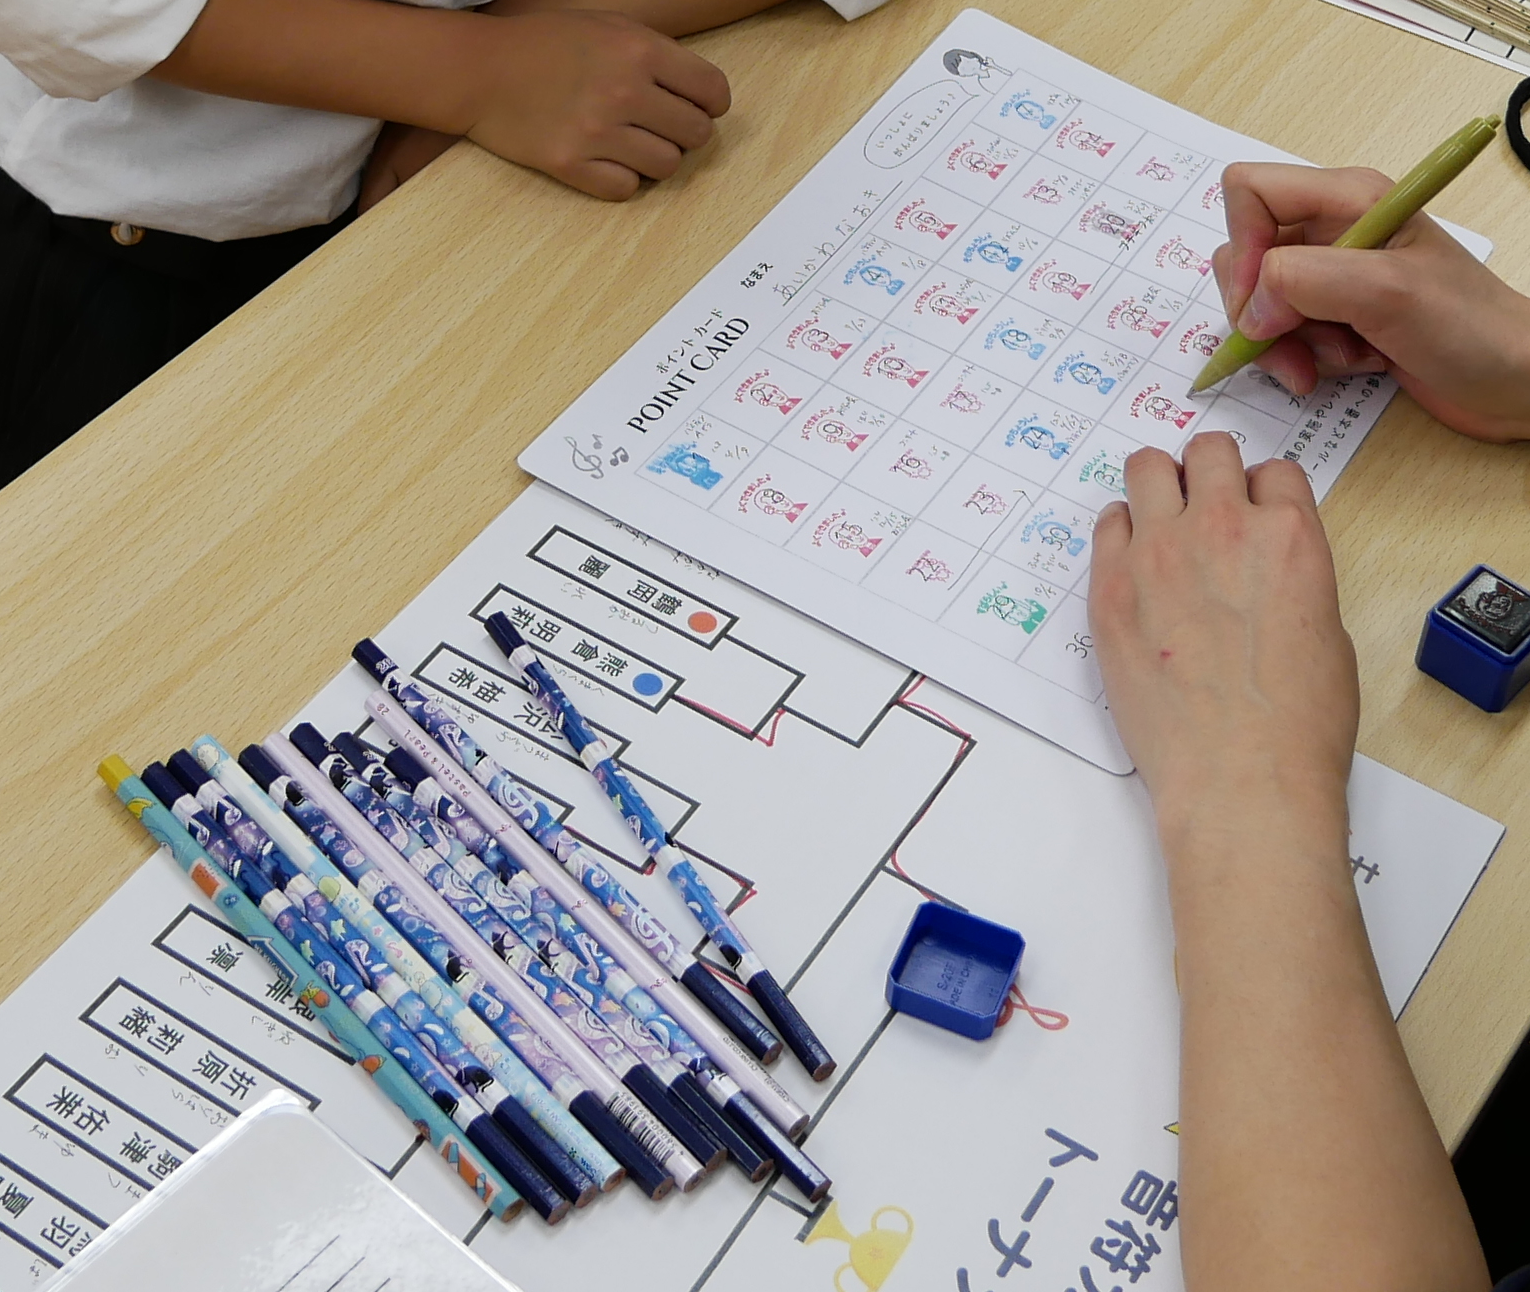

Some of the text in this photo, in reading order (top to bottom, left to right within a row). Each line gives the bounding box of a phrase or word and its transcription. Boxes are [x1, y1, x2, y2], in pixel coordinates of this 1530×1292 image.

[875, 111, 913, 149] いっしょに
[1145, 162, 1171, 181] 21
[1032, 185, 1058, 204] 13
[914, 211, 937, 226] 5
[1098, 213, 1126, 235] 20
[740, 262, 774, 289] なまえ
[1051, 272, 1077, 293] 19
[656, 308, 723, 374] ポイント カード
[807, 328, 830, 343] 3
[1001, 329, 1029, 351] 18
[626, 368, 696, 434] POINT
[690, 318, 750, 371] CARD
[877, 357, 905, 380] 10
[948, 390, 978, 413] 17
[822, 423, 844, 439] 9
[1019, 426, 1048, 450] 24
[889, 454, 922, 477] 16
[760, 488, 786, 504] 8
[962, 490, 996, 515] 23
[834, 520, 863, 545] 15
[1041, 527, 1072, 551] 30
[578, 554, 683, 616] 鶴岡 麗
[570, 638, 629, 677] 熊倉
[1065, 632, 1102, 659] 36
[448, 667, 507, 704] 柚希
[376, 702, 390, 716] 2B
[404, 729, 432, 762] Pearl
[434, 763, 472, 804] Pastel
[946, 985, 965, 1007] ADE
[118, 1006, 257, 1101] 折原 莉緒
